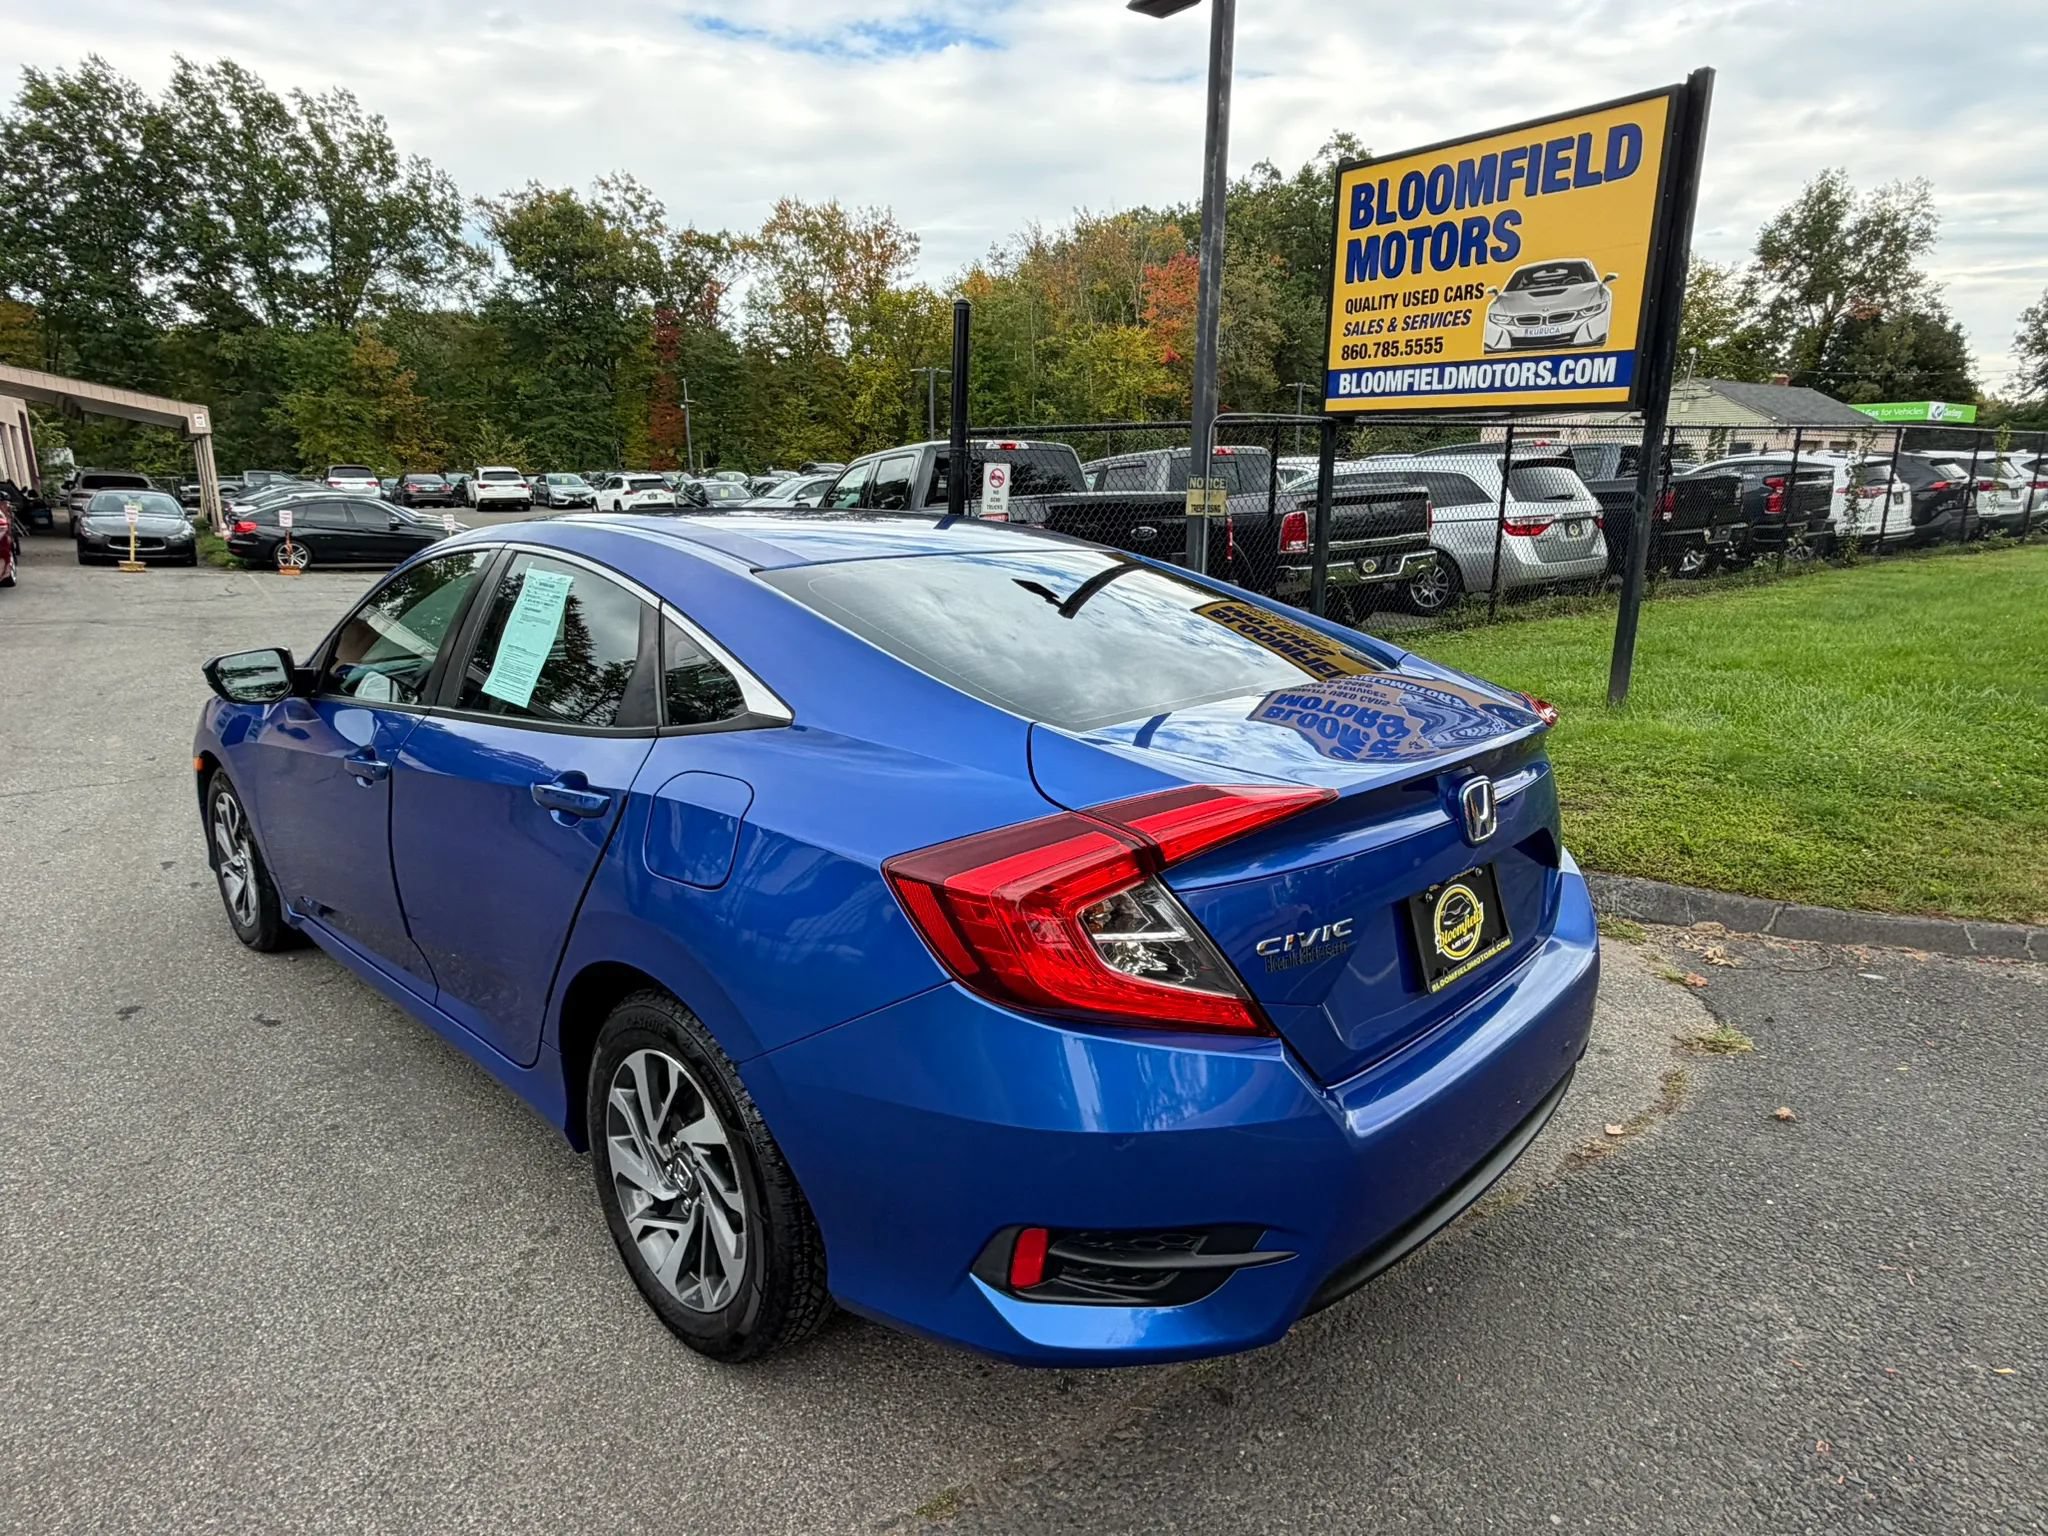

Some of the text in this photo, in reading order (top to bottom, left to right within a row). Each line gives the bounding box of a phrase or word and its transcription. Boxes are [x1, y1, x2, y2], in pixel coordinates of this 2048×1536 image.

[1349, 123, 1643, 230] BLOOMFIELD
[1345, 209, 1522, 284] MOTORS
[1345, 282, 1485, 314] QUALITY USED CARS
[1343, 309, 1472, 337] SALES & SERVICES
[1341, 336, 1444, 361] 860.785.5555
[1338, 356, 1617, 395] BLOOMFIELDMOTORS.COM
[1881, 408, 1892, 416] for
[1894, 407, 1924, 416] Vehicles
[1189, 477, 1226, 489] NOICE
[1256, 918, 1353, 956] CIVIC
[1431, 938, 1511, 992] BLOOMFIELDMOTORS.COM
